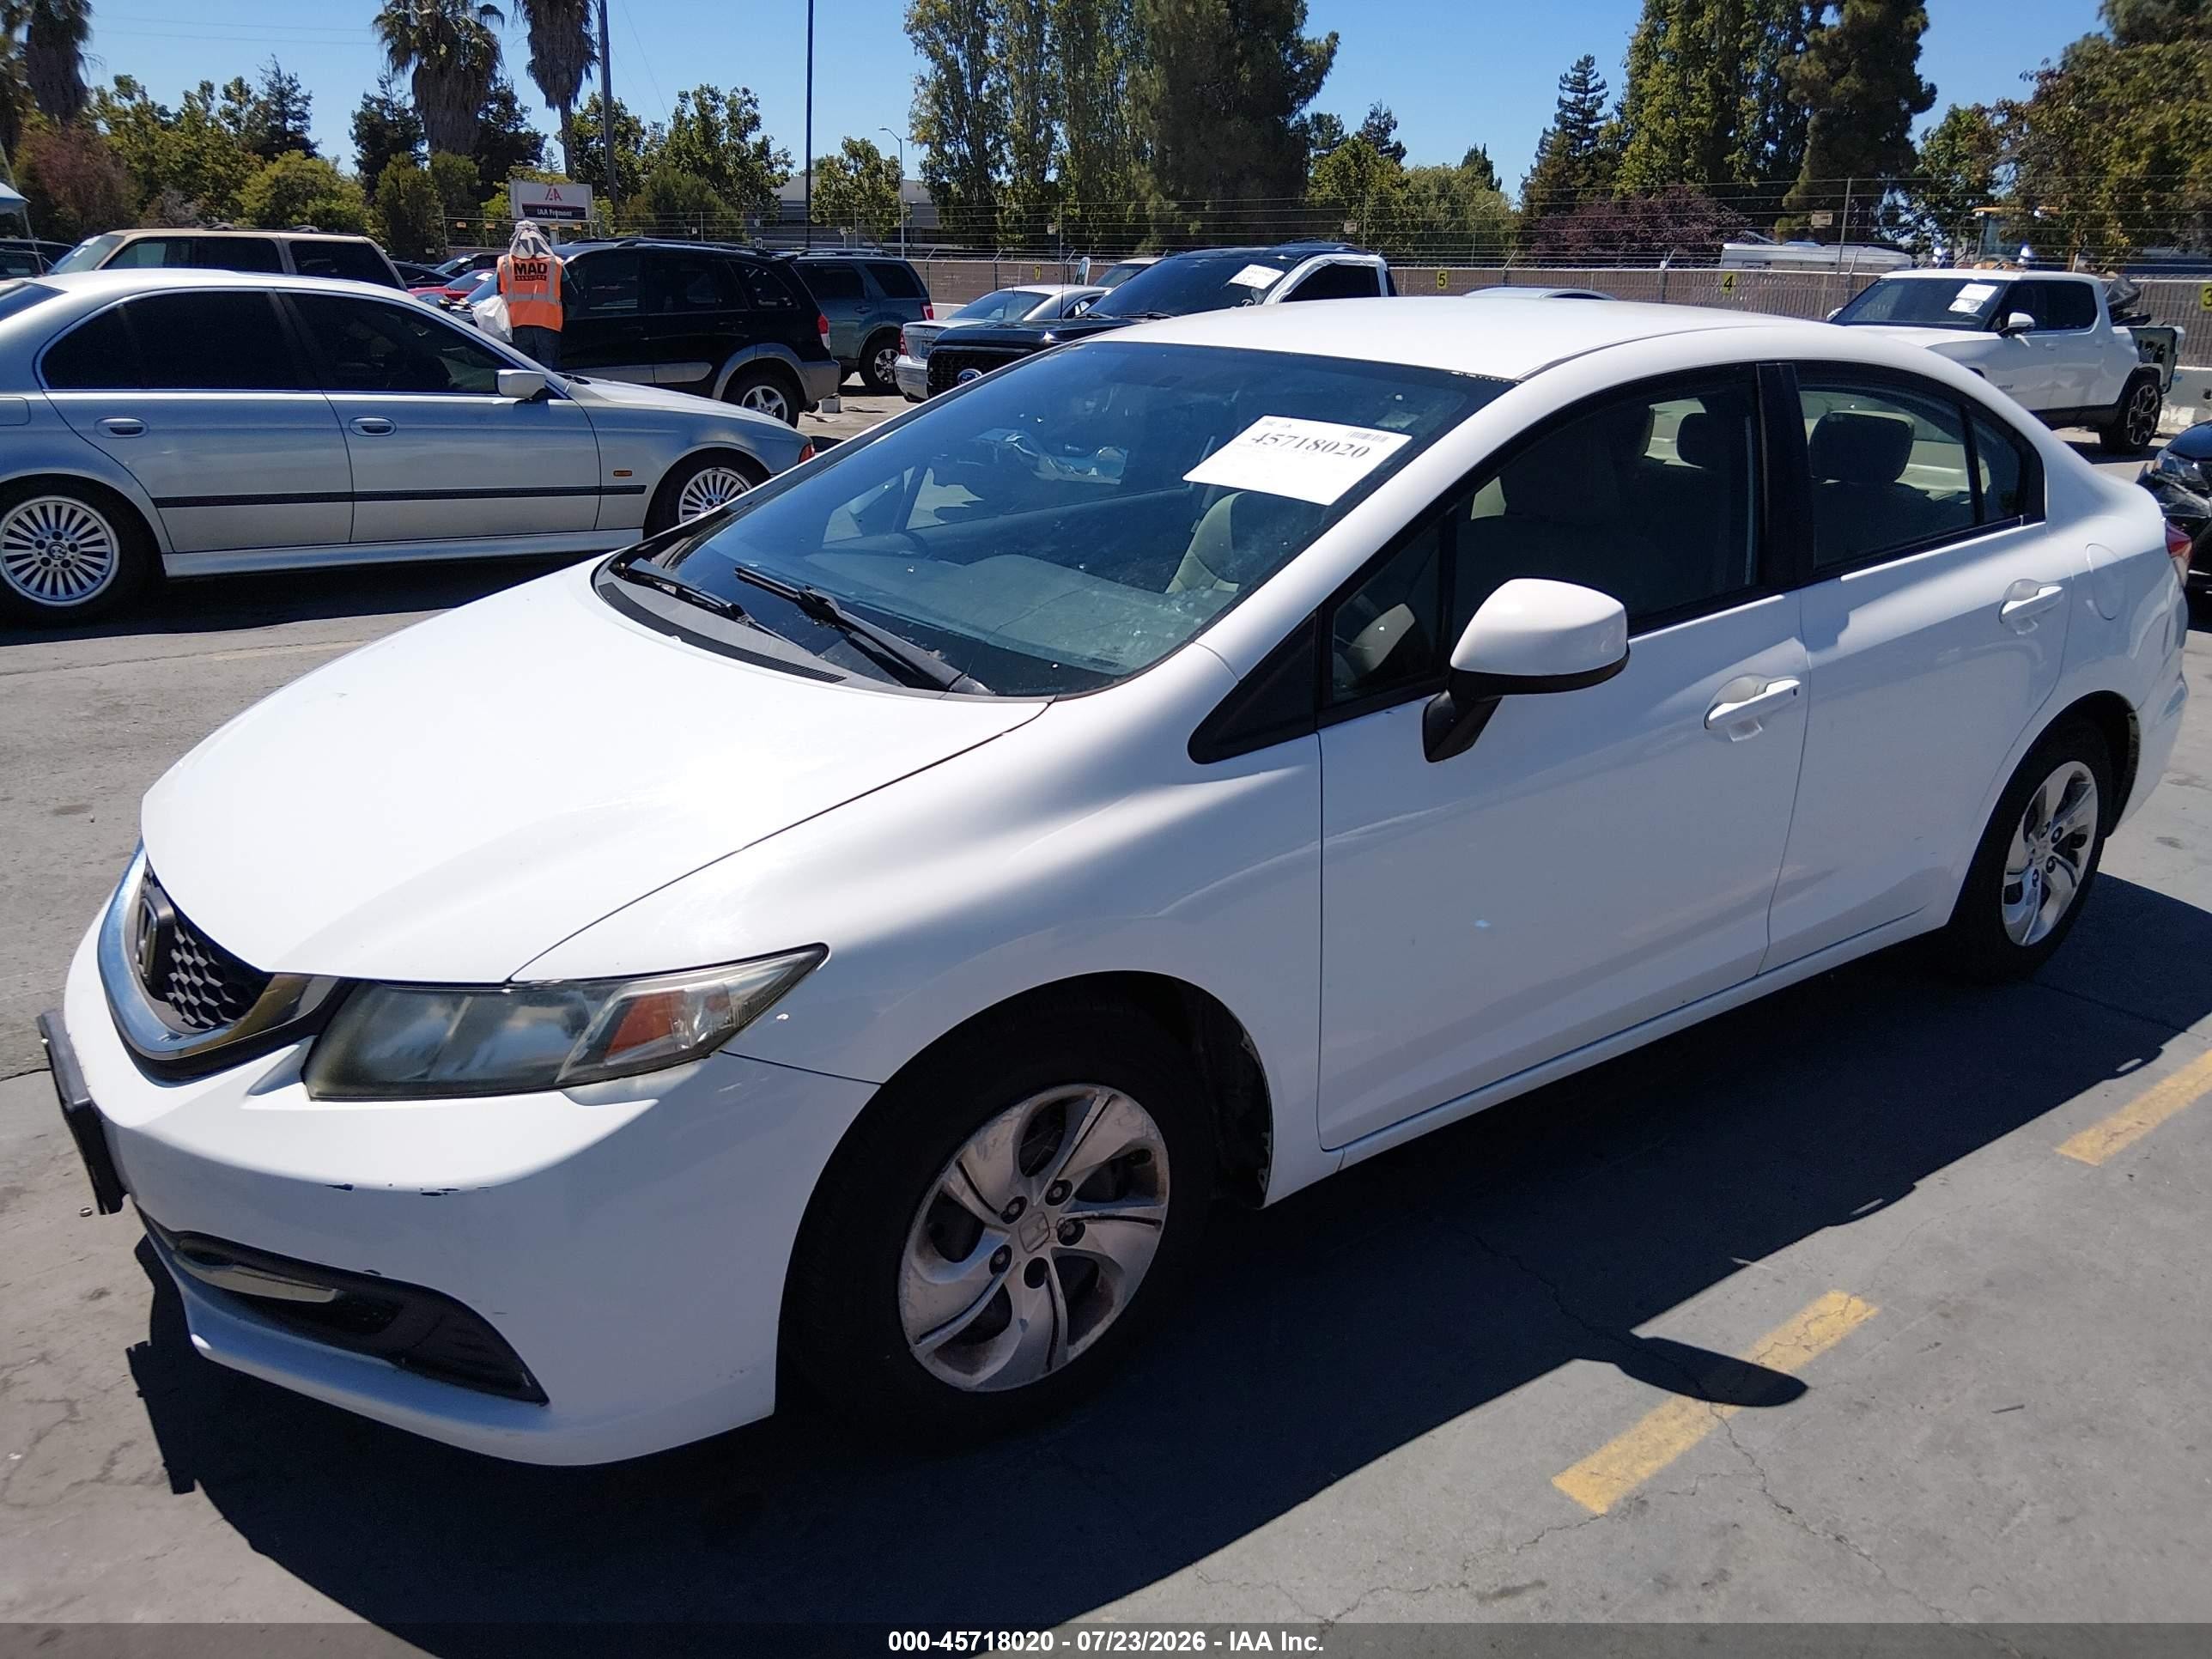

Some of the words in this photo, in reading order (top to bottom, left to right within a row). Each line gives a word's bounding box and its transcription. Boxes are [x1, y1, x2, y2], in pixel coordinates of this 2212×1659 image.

[514, 262, 548, 276] MAD
[1438, 273, 1446, 287] 5
[1723, 275, 1733, 291] 4
[2203, 288, 2212, 307] 3
[1251, 432, 1370, 459] 45718020
